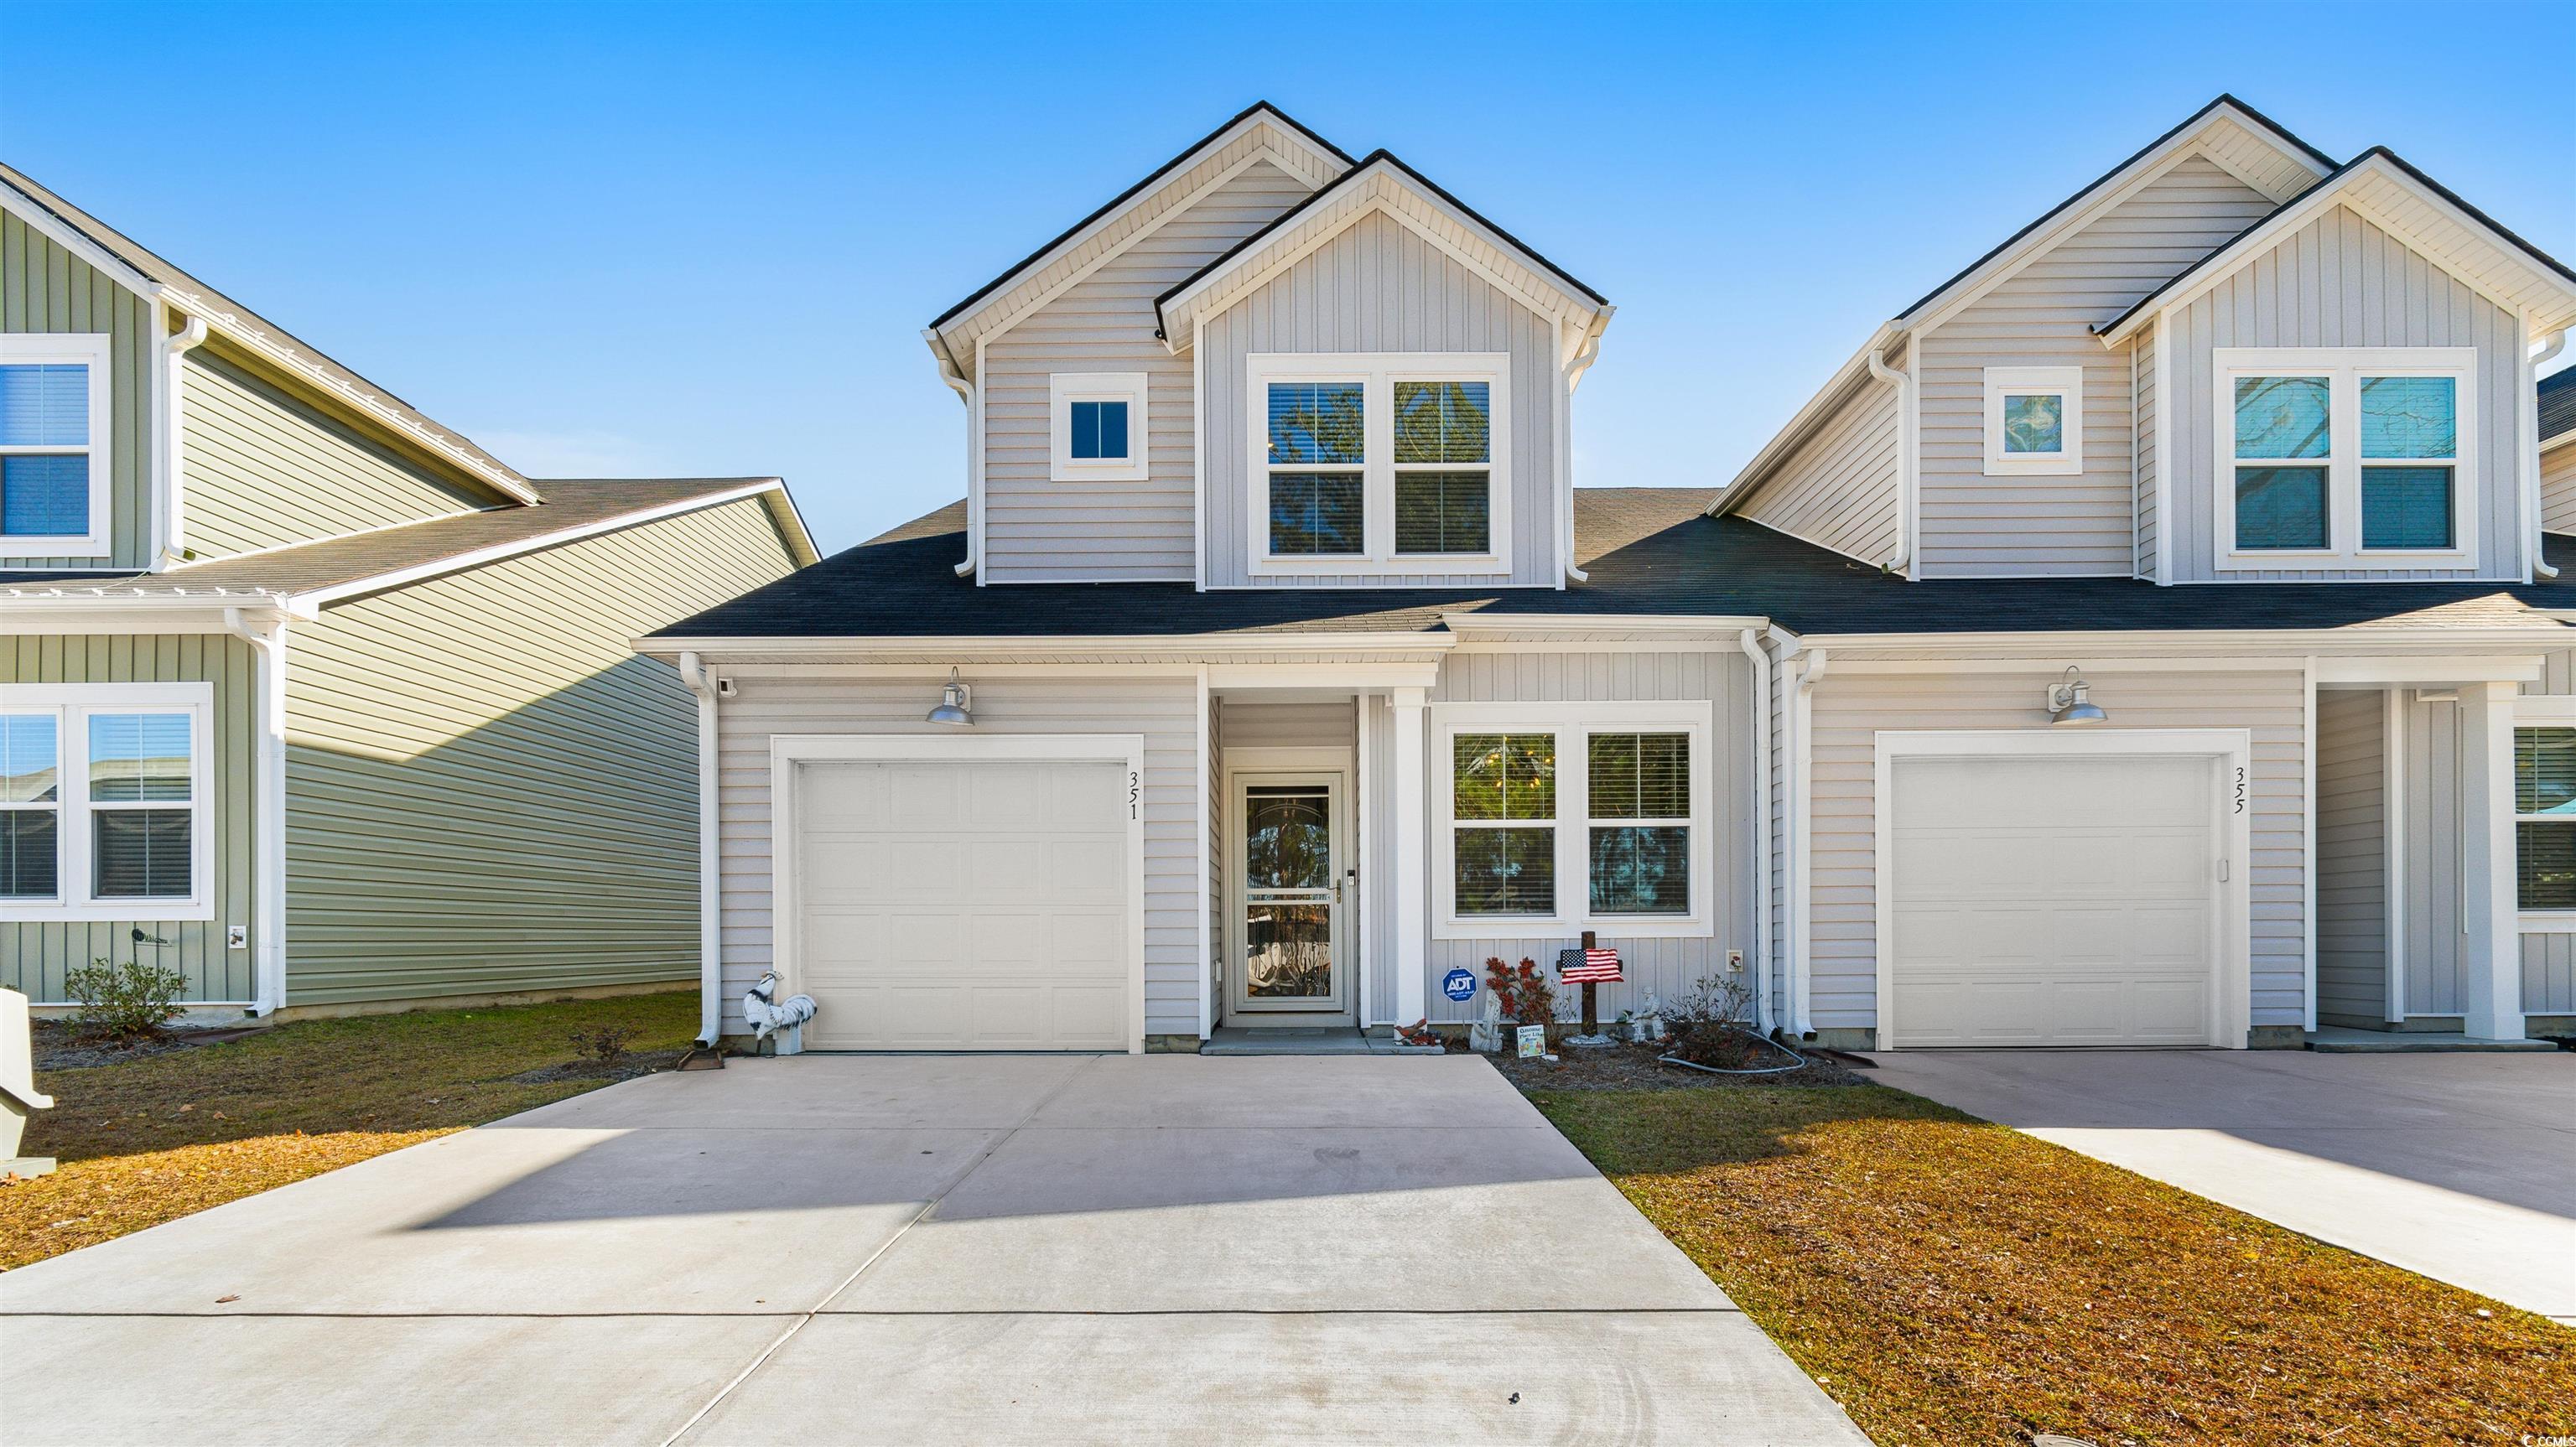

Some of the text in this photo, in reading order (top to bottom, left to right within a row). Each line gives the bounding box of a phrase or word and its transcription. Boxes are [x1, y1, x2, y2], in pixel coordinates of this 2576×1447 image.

[1129, 771, 1139, 820] 351
[2234, 766, 2245, 814] 355
[1446, 977, 1473, 992] ADT
